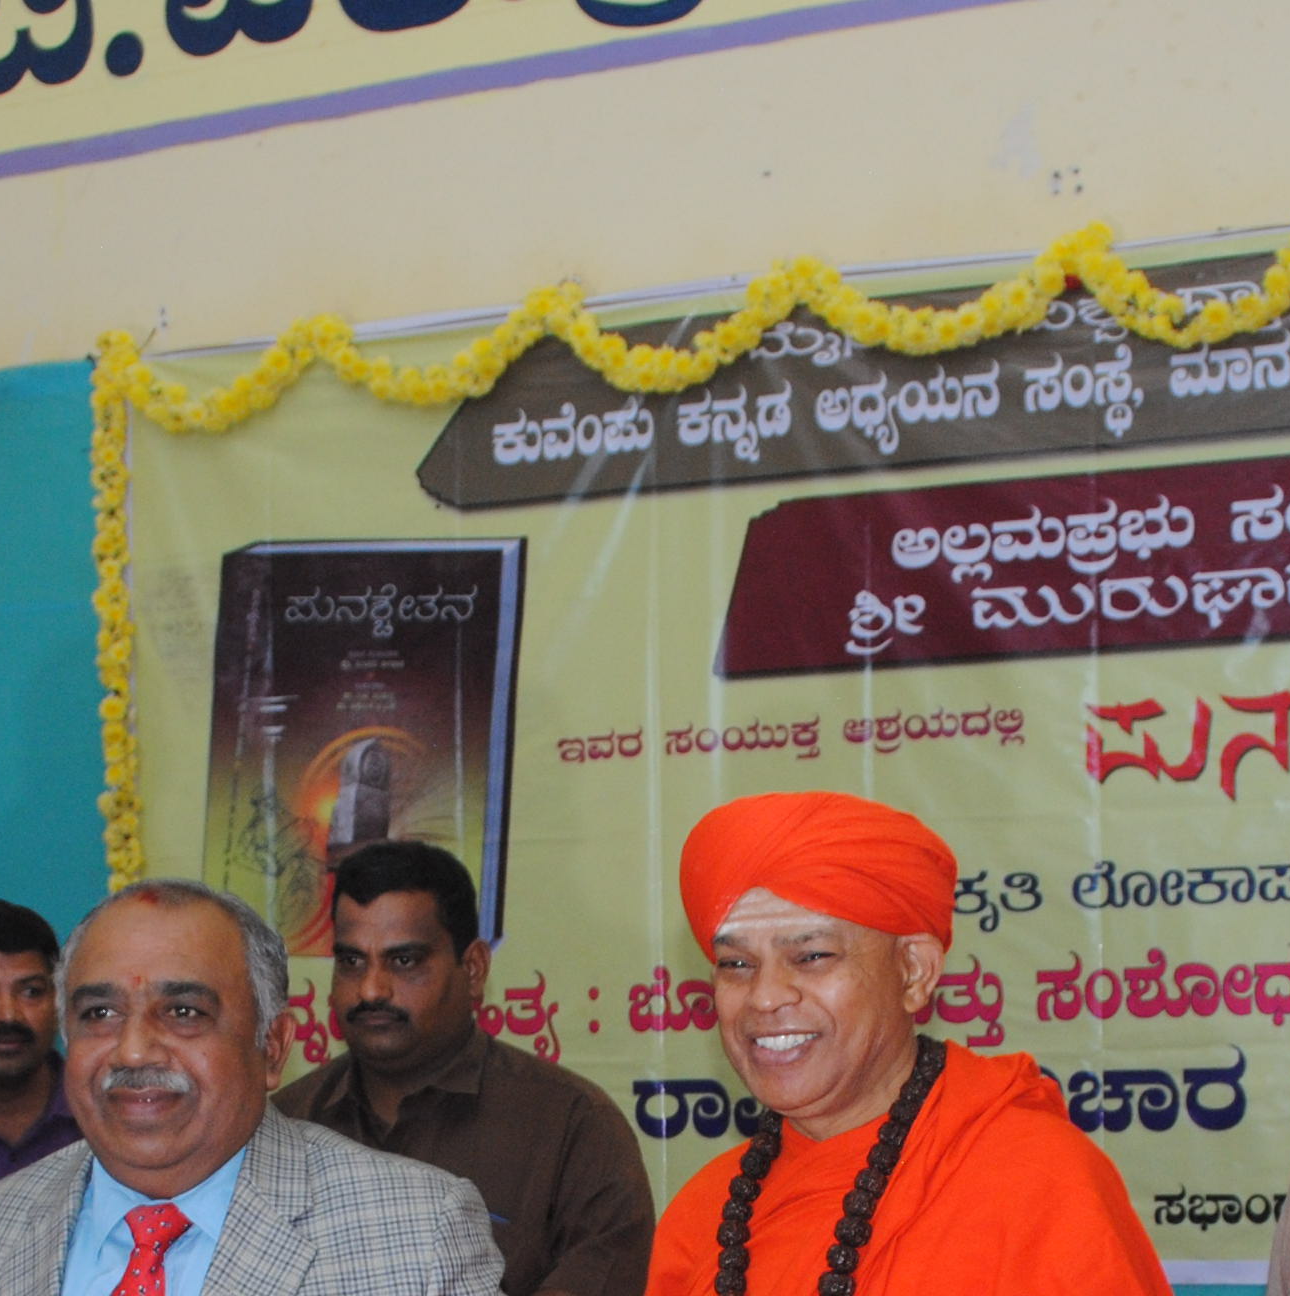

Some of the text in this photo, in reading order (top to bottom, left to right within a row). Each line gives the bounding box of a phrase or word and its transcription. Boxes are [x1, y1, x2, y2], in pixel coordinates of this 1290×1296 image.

[492, 400, 653, 464] ಕುವೆಂಪು
[678, 381, 792, 462] ಕನ್ನಡ
[817, 360, 1000, 454] ಅಧ್ಯಯನ
[891, 494, 1195, 582] ಅಲ್ಲಮಪ್ರಭು
[284, 583, 479, 638] ಪುನಶ್ಚೇತನ
[845, 588, 926, 655] ಶ್ರೀ
[557, 704, 1026, 763] ಇವರ ಸಂಯುಕ್ತ ಆಶ್ರಯದಲ್ಲಿ
[953, 870, 1043, 933] ಕೃತಿ
